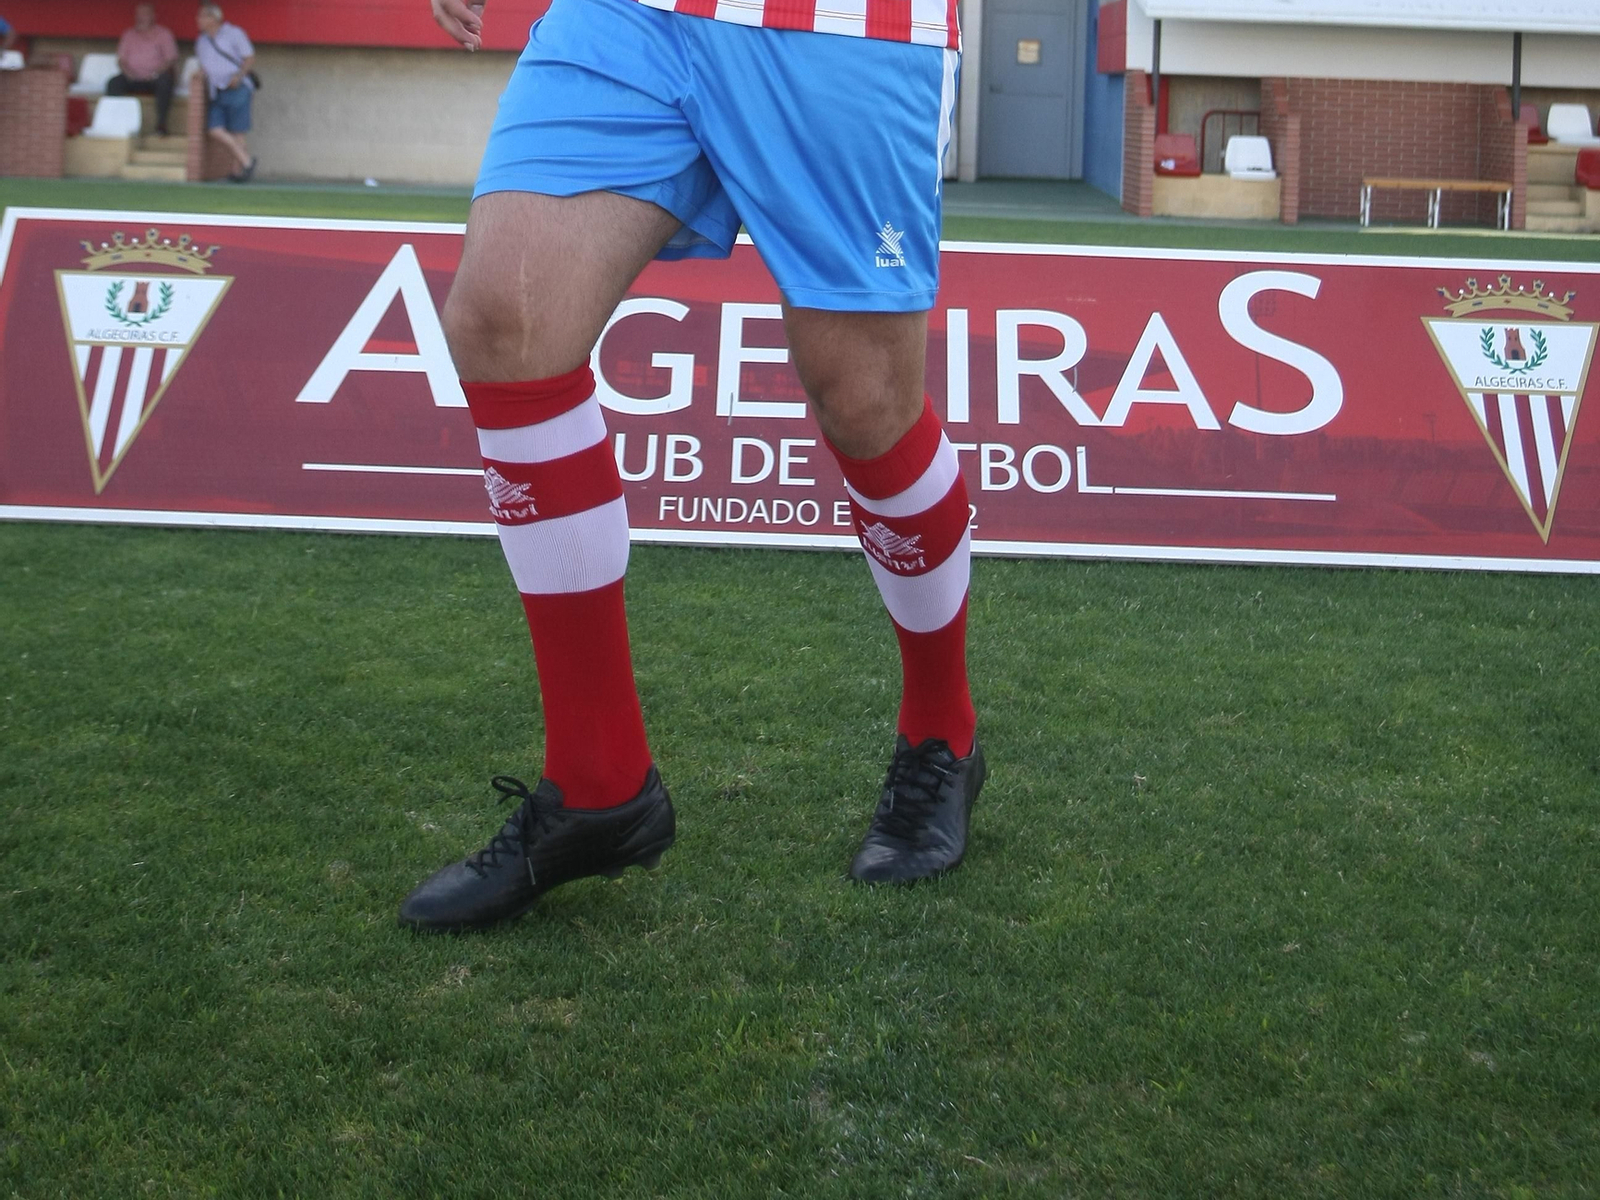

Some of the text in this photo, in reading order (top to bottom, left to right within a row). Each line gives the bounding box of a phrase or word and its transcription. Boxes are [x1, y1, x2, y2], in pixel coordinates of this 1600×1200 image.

[295, 243, 1344, 436] AGEIRAS
[1475, 375, 1568, 390] ALGECIRAS C.F.
[730, 437, 816, 486] DE
[658, 496, 820, 526] FUNDADO
